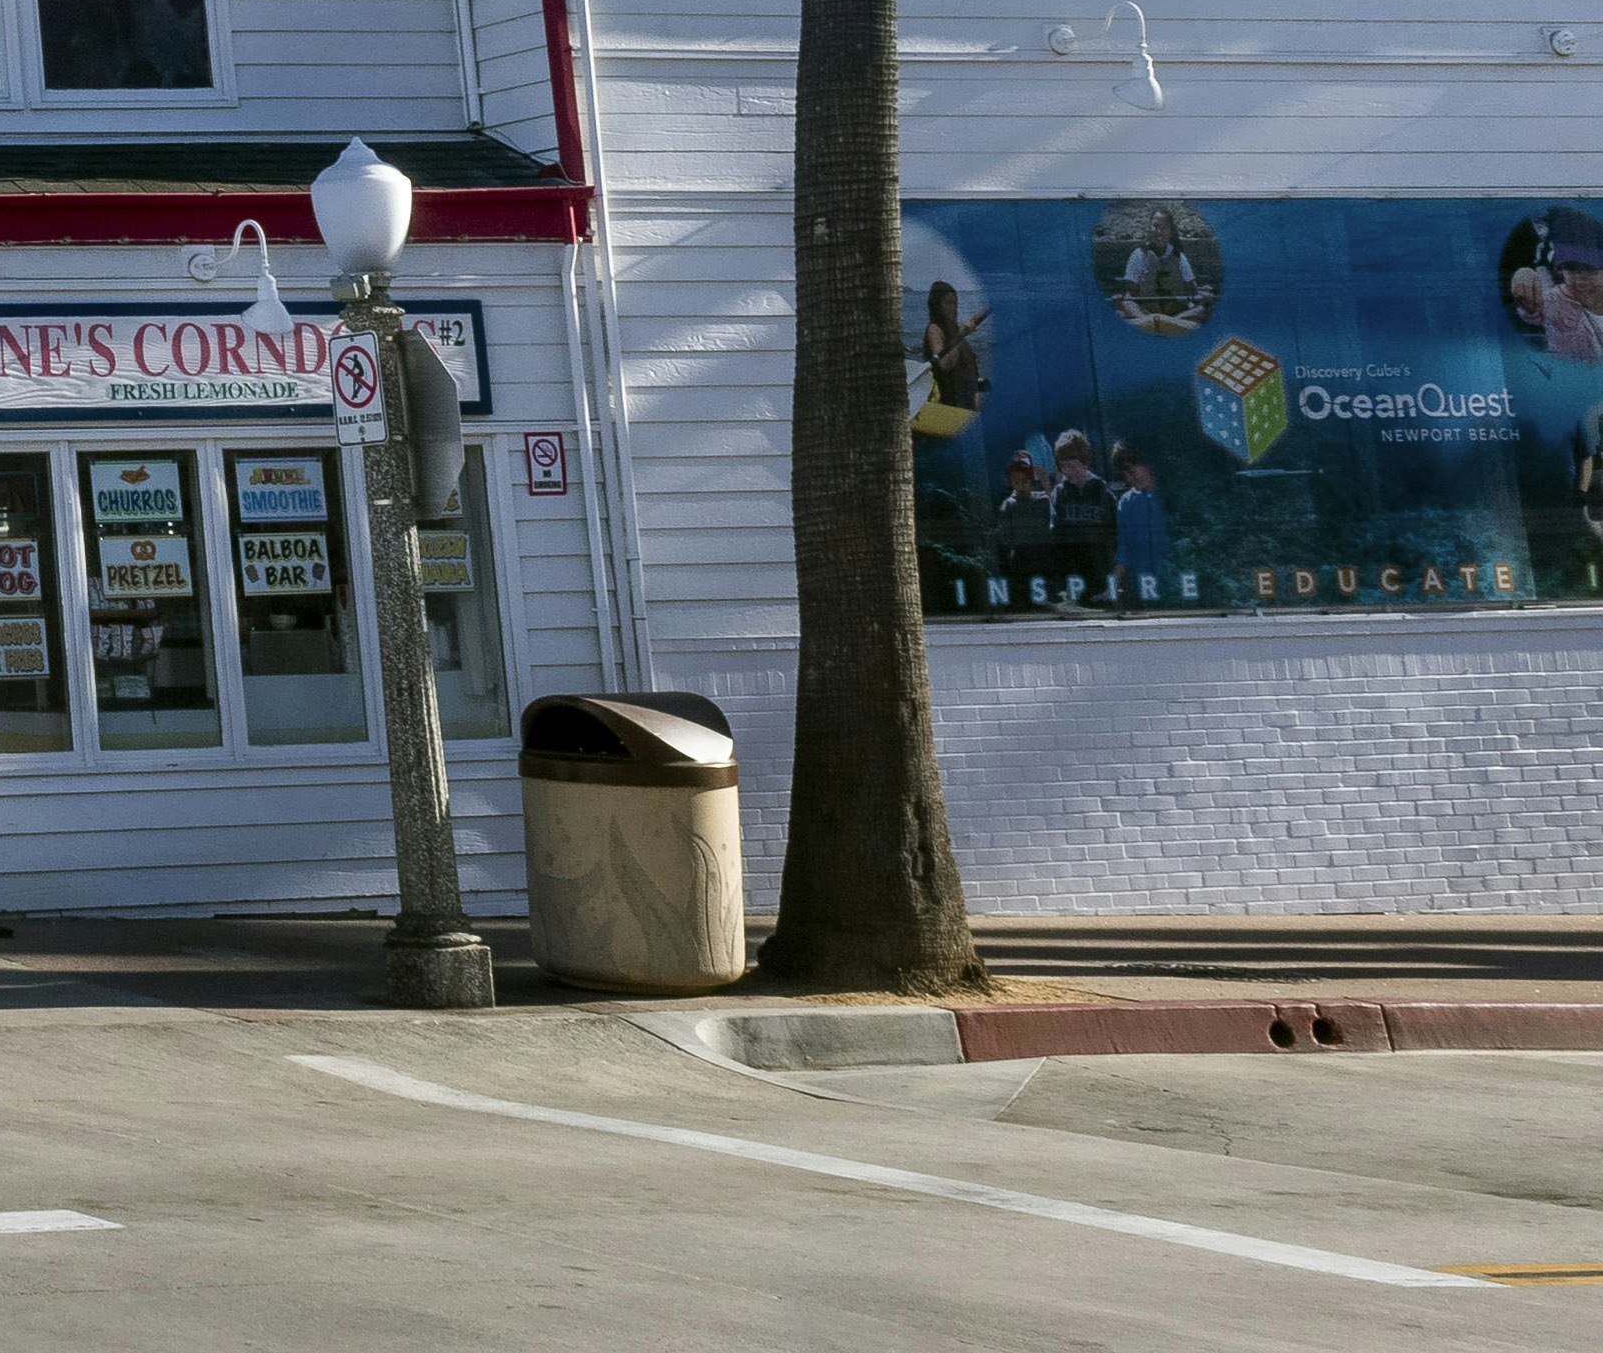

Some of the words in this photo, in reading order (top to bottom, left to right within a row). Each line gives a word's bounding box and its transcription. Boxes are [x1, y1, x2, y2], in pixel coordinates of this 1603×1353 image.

[439, 319, 467, 347] #2
[1295, 365, 1363, 381] Discovery
[1366, 364, 1411, 378] Cube's
[109, 382, 176, 400] FRESH
[183, 381, 299, 400] LEMONADE
[1299, 382, 1517, 420] OceanQuest
[1381, 428, 1463, 443] NEWPORT
[1468, 427, 1521, 442] BEACH
[97, 488, 178, 514] CHURROS
[242, 489, 323, 512] SMOOTHIE
[243, 539, 324, 561] BALBOA
[105, 563, 188, 590] PRETZEL
[264, 564, 308, 587] BAR
[954, 573, 1199, 606] INSPIRE
[1255, 564, 1515, 597] EDUCATE
